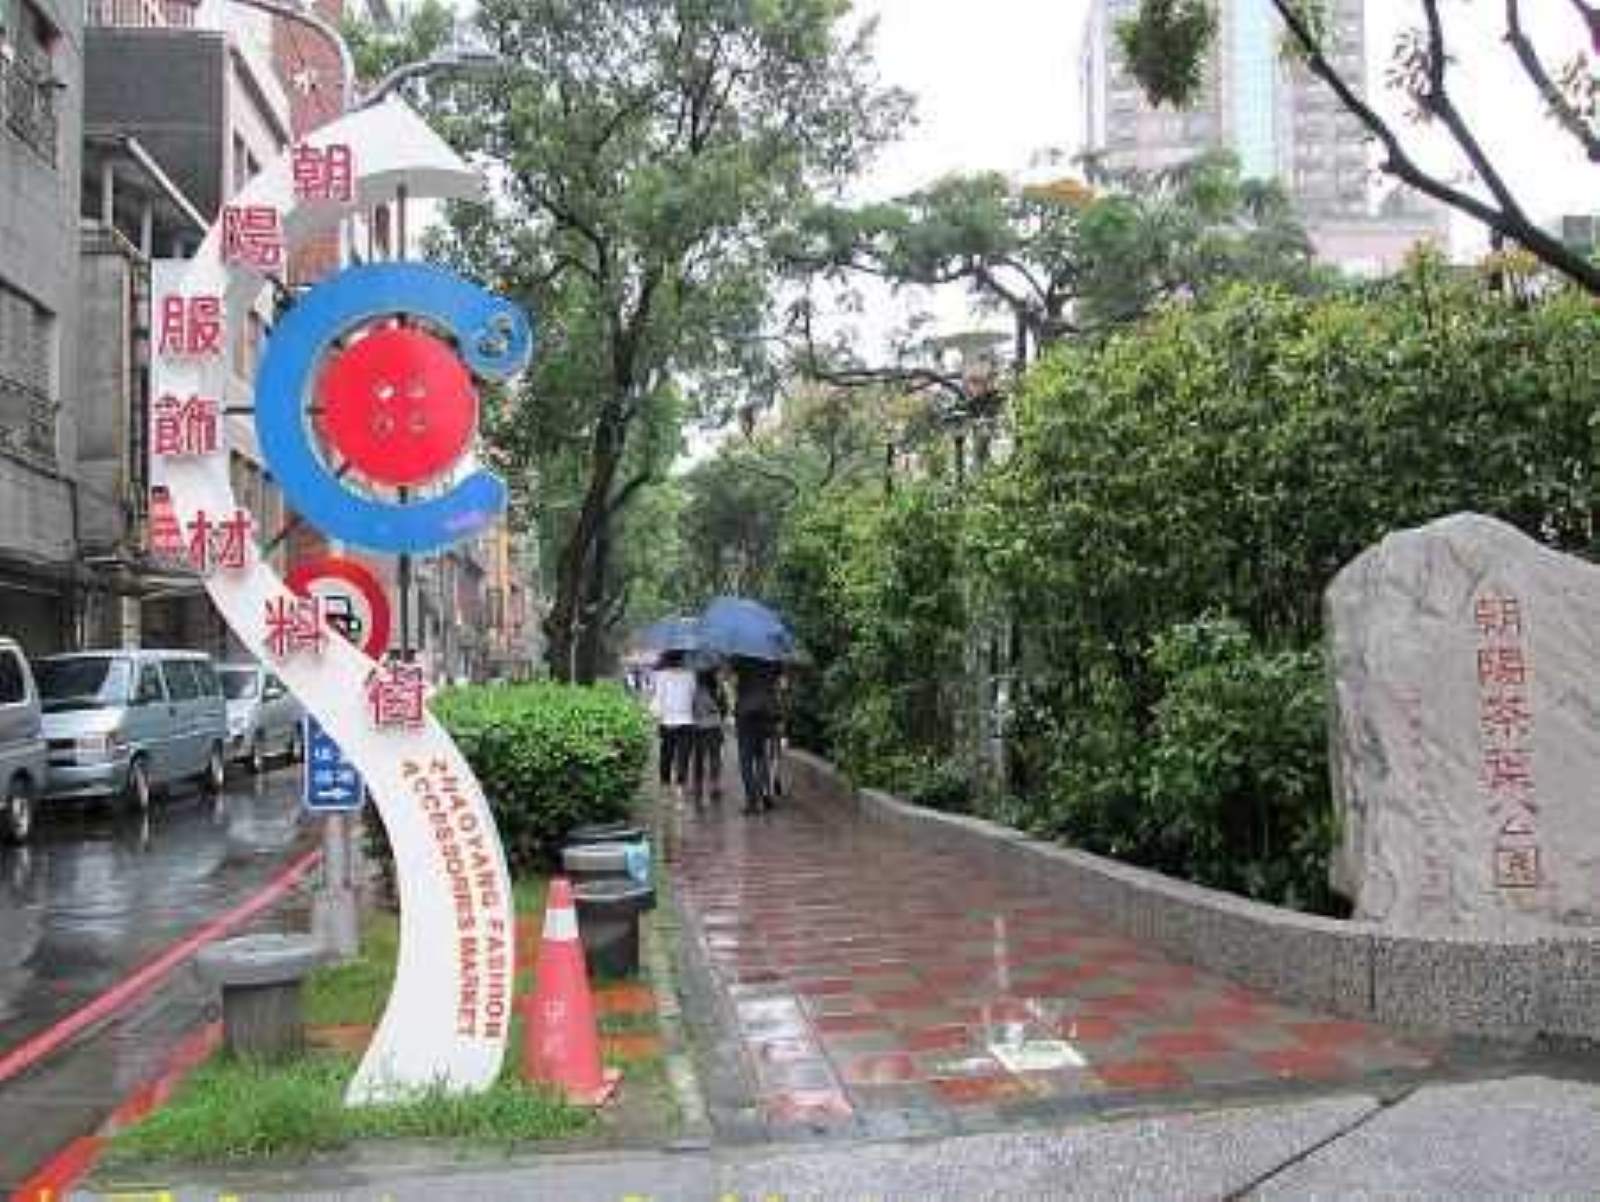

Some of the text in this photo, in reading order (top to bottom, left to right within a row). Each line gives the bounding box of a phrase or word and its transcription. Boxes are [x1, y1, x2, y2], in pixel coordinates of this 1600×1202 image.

[152, 143, 424, 730] 朝陽服飾材料街
[1474, 594, 1537, 889] 朝陽茶葉公園
[403, 760, 480, 1039] ACCESSORIES MARKET
[428, 756, 506, 1039] ZHAOYANG FASHION
